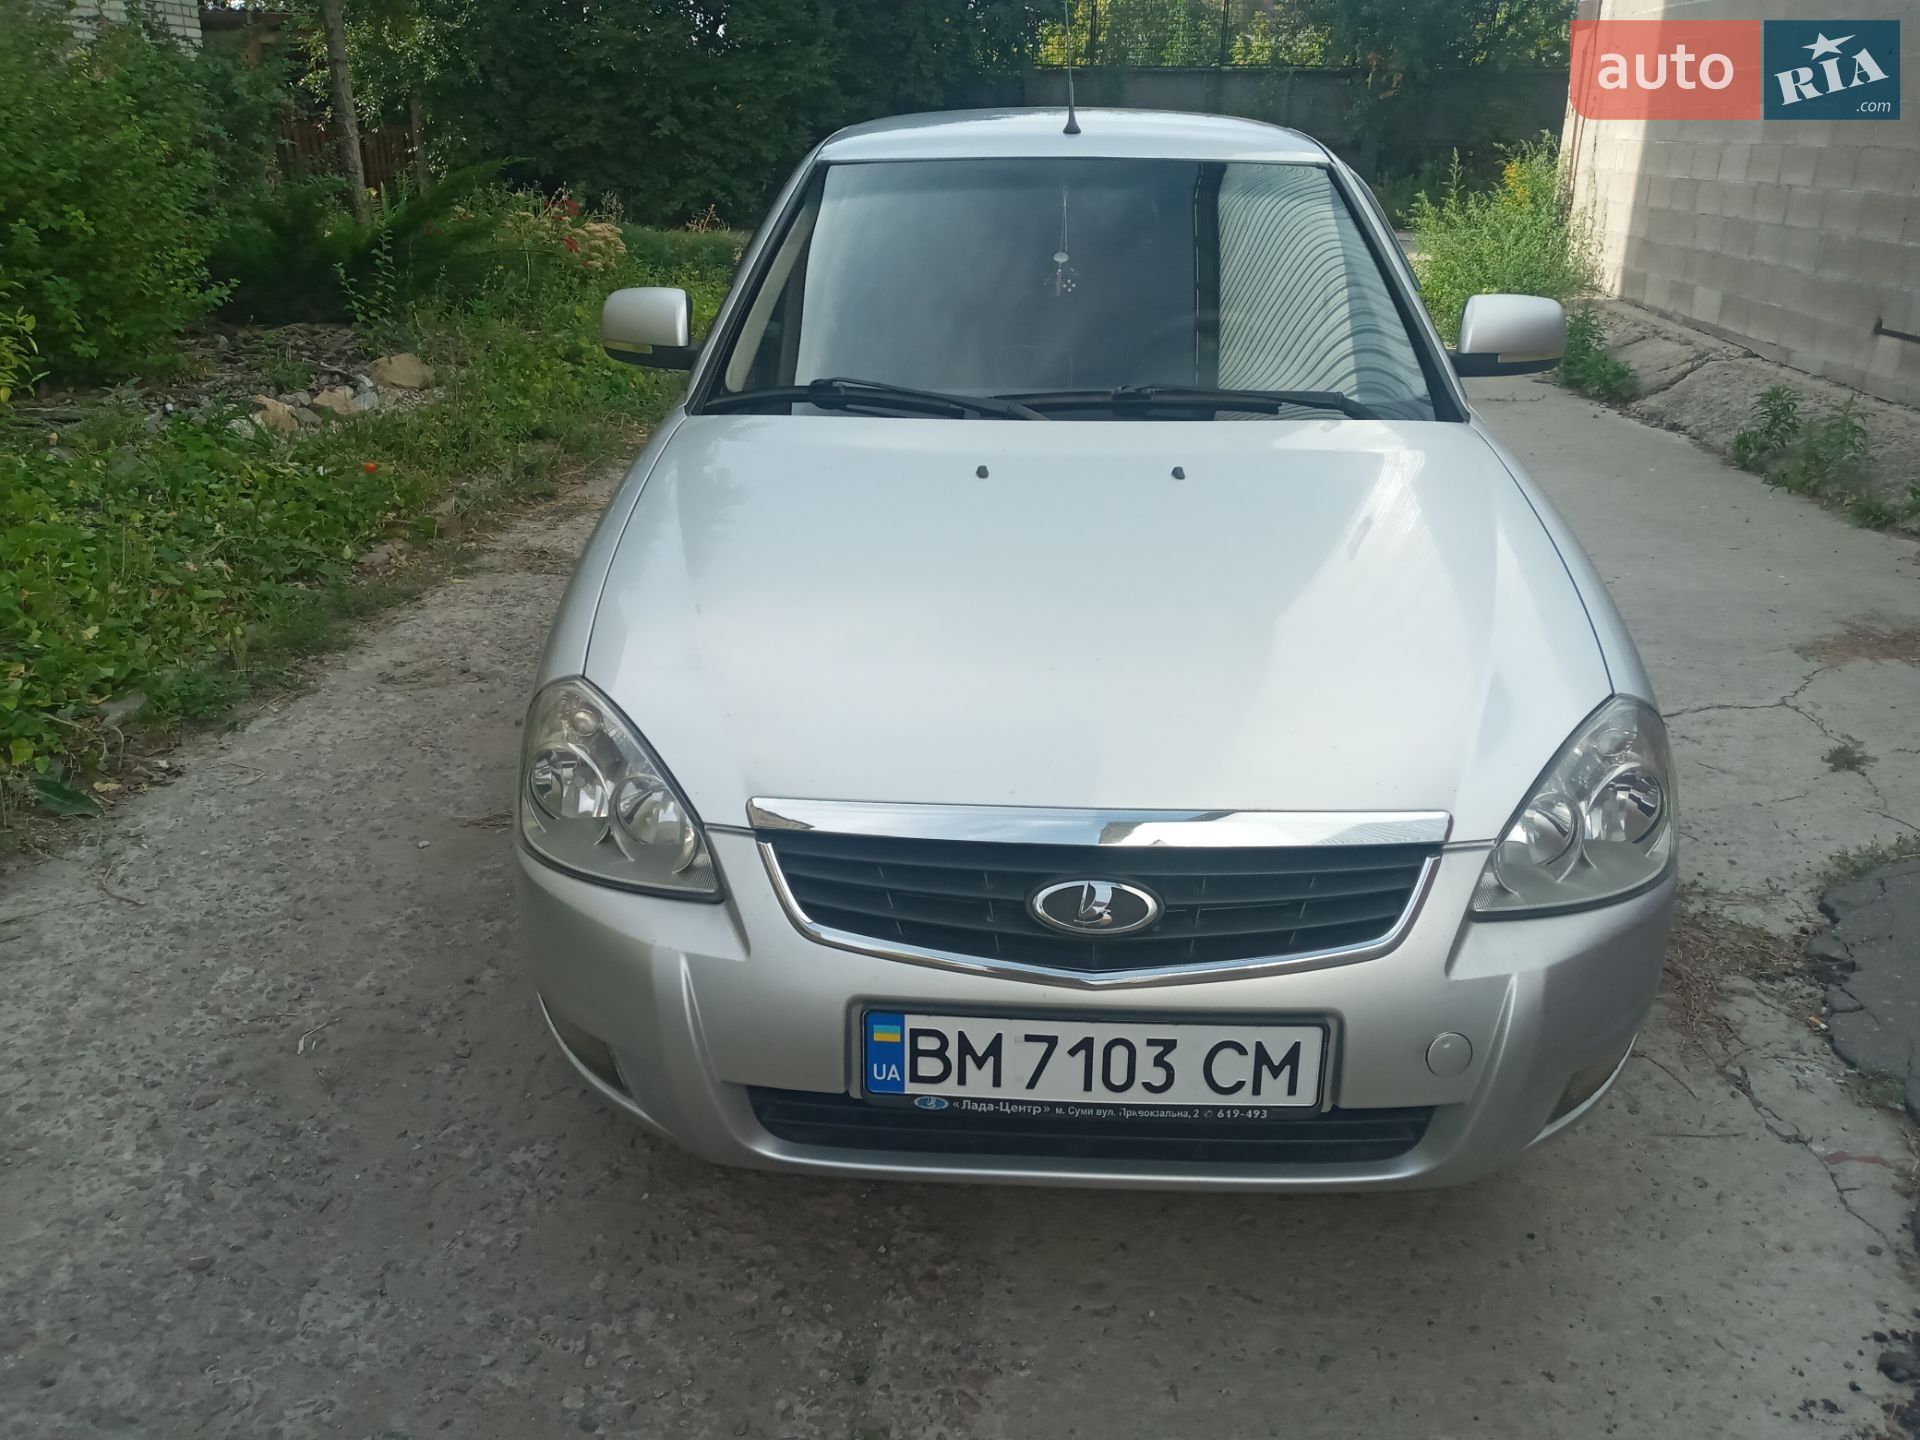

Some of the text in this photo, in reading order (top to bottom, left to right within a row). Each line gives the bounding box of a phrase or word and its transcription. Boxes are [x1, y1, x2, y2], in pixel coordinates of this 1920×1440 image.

[909, 1028, 1302, 1097] BM 7103 CM
[873, 1063, 901, 1081] UA
[1055, 1106, 1065, 1115] м.
[1067, 1106, 1094, 1117] Суми
[1193, 1108, 1200, 1118] 2
[1216, 1108, 1268, 1119] 619-493
